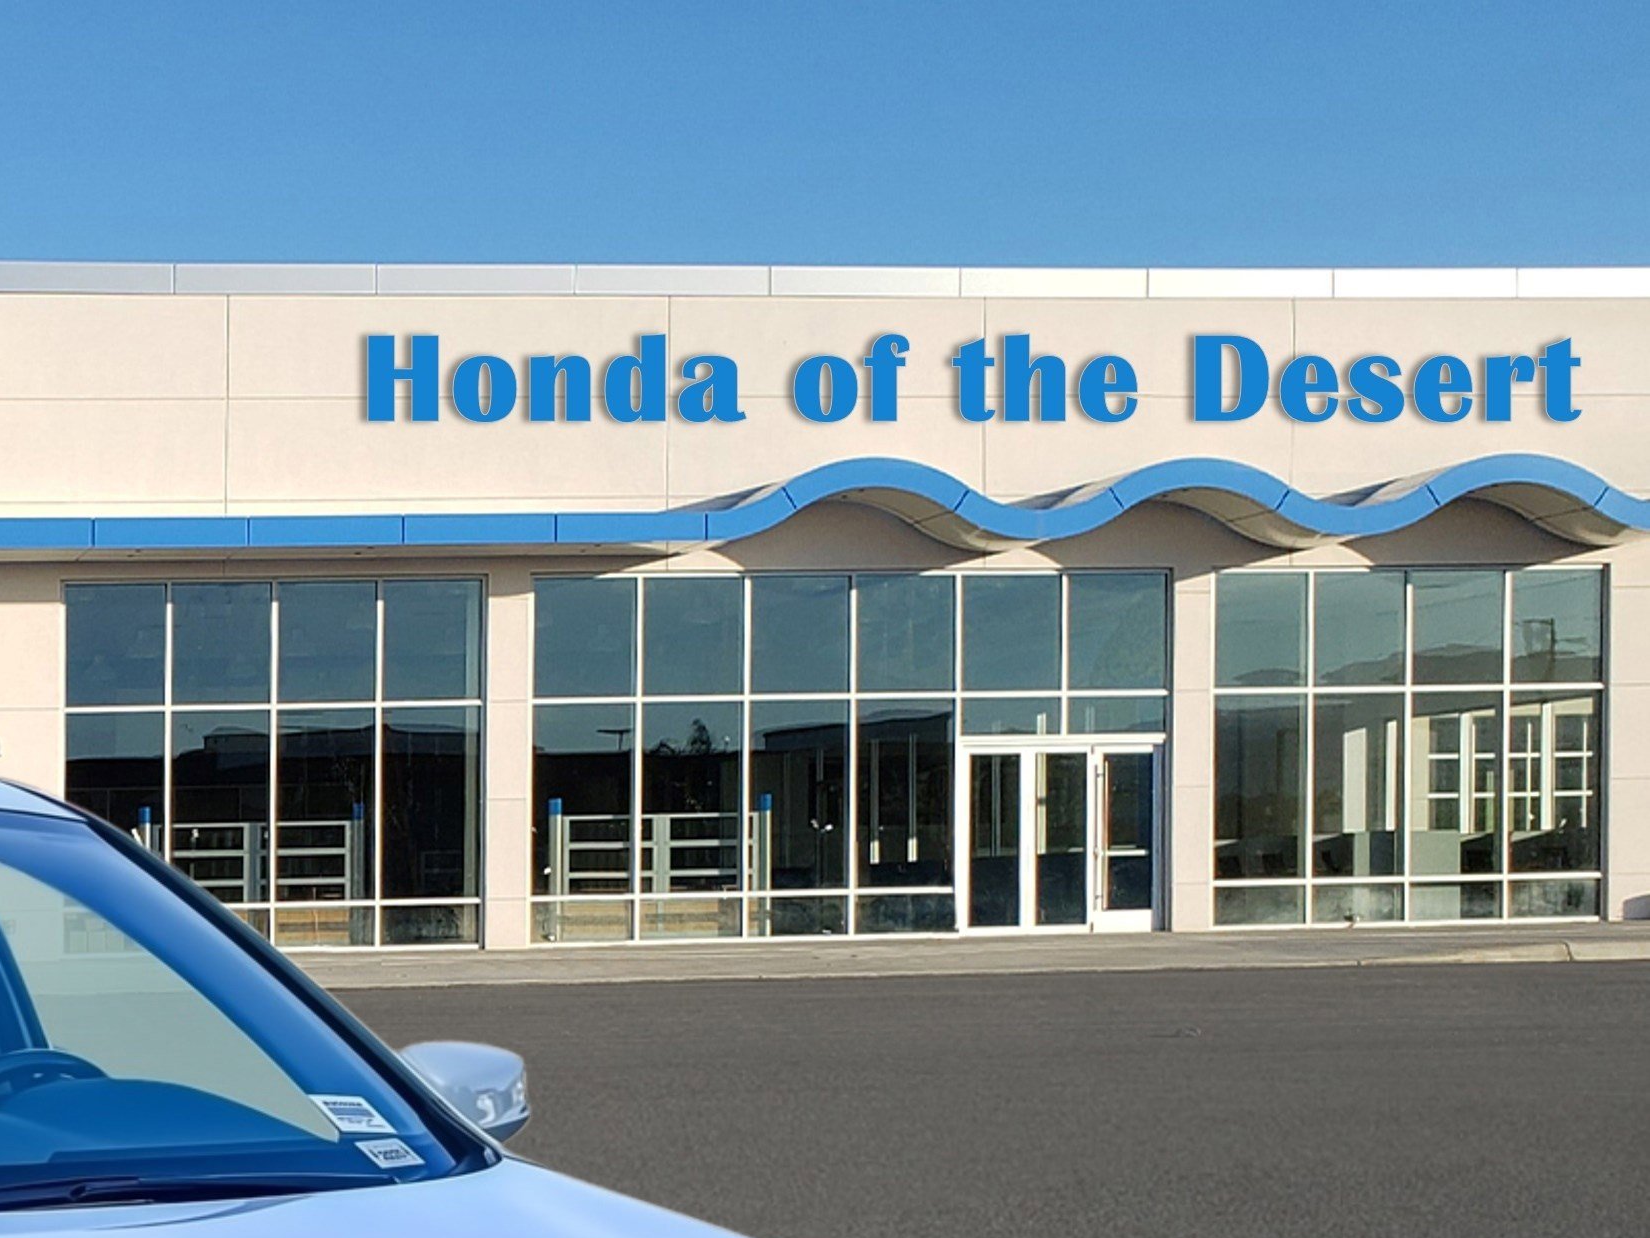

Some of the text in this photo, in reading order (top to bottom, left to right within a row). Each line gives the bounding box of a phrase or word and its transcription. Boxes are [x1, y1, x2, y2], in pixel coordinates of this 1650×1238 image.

[363, 333, 1583, 423] Honda of the Desert
